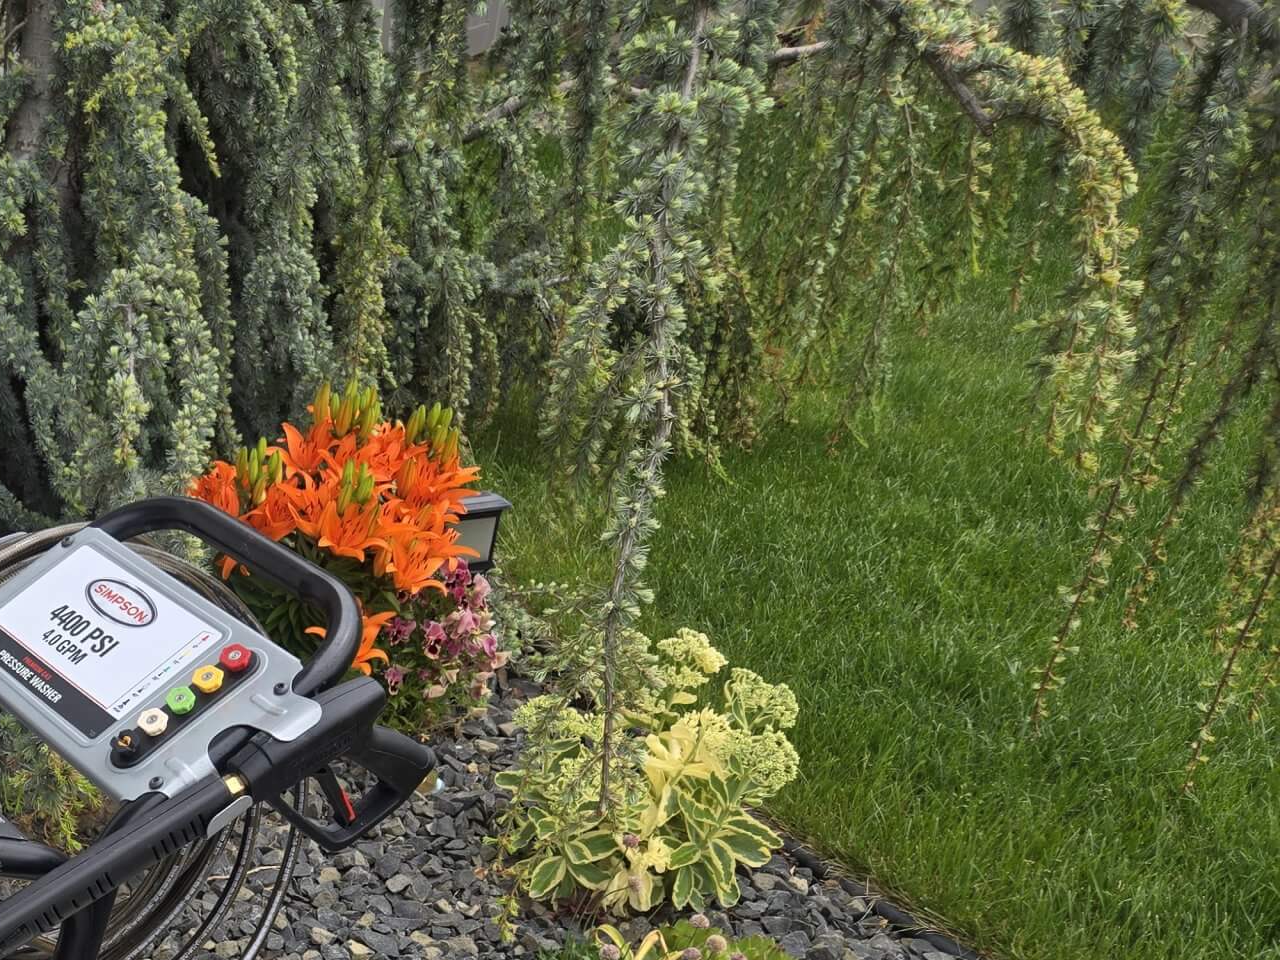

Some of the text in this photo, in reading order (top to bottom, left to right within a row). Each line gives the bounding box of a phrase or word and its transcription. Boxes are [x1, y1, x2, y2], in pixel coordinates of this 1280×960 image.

[94, 583, 149, 624] SIMPSON
[42, 629, 89, 665] 4.0 GPM
[49, 604, 120, 657] 4400 PSI
[29, 673, 63, 704] WASHER
